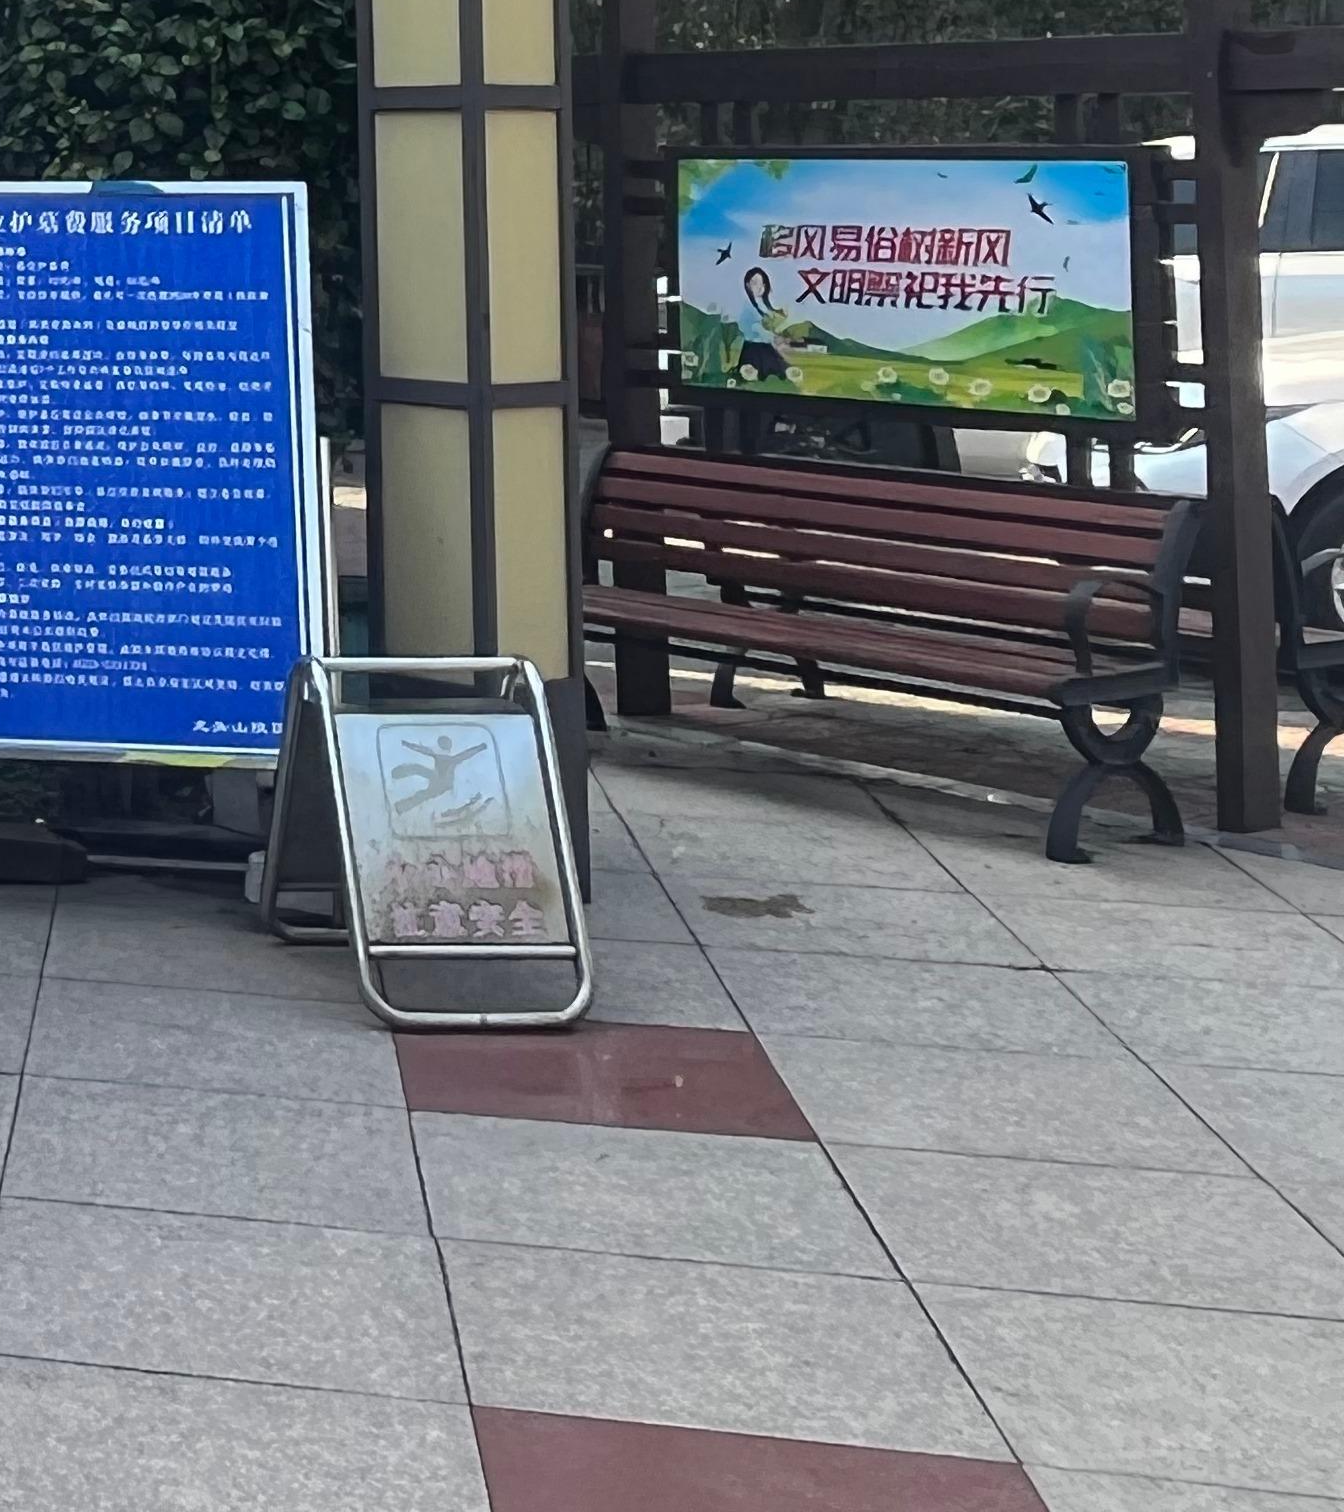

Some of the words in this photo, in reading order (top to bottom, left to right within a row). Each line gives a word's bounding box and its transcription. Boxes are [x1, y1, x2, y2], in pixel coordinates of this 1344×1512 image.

[759, 224, 1012, 267] 移风易俗树新风
[796, 268, 1058, 315] 文明祭祀我先行
